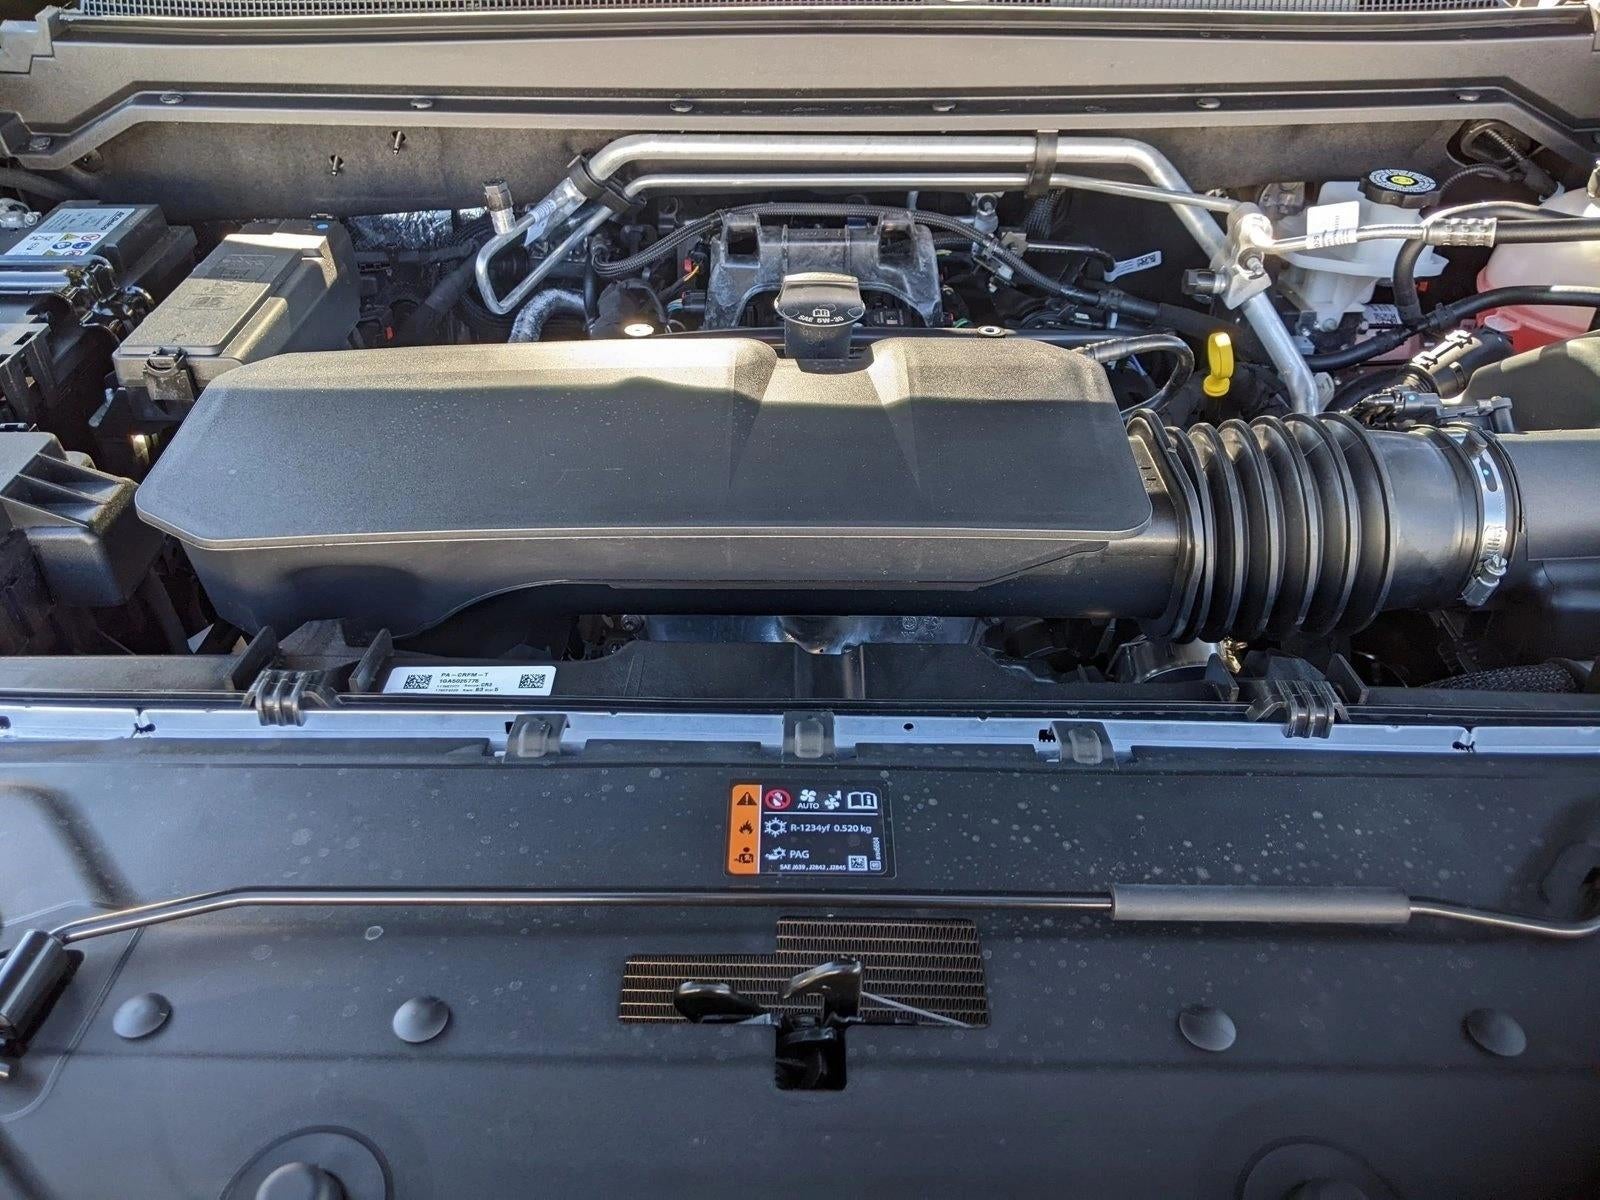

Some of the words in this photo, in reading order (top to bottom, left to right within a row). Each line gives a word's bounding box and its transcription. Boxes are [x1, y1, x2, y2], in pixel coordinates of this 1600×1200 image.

[798, 315, 814, 323] SAE
[816, 315, 844, 323] 5W-30
[790, 824, 831, 833] R-1234yf
[833, 824, 859, 832] 0.520
[860, 824, 872, 834] kg
[789, 850, 810, 859] PAG
